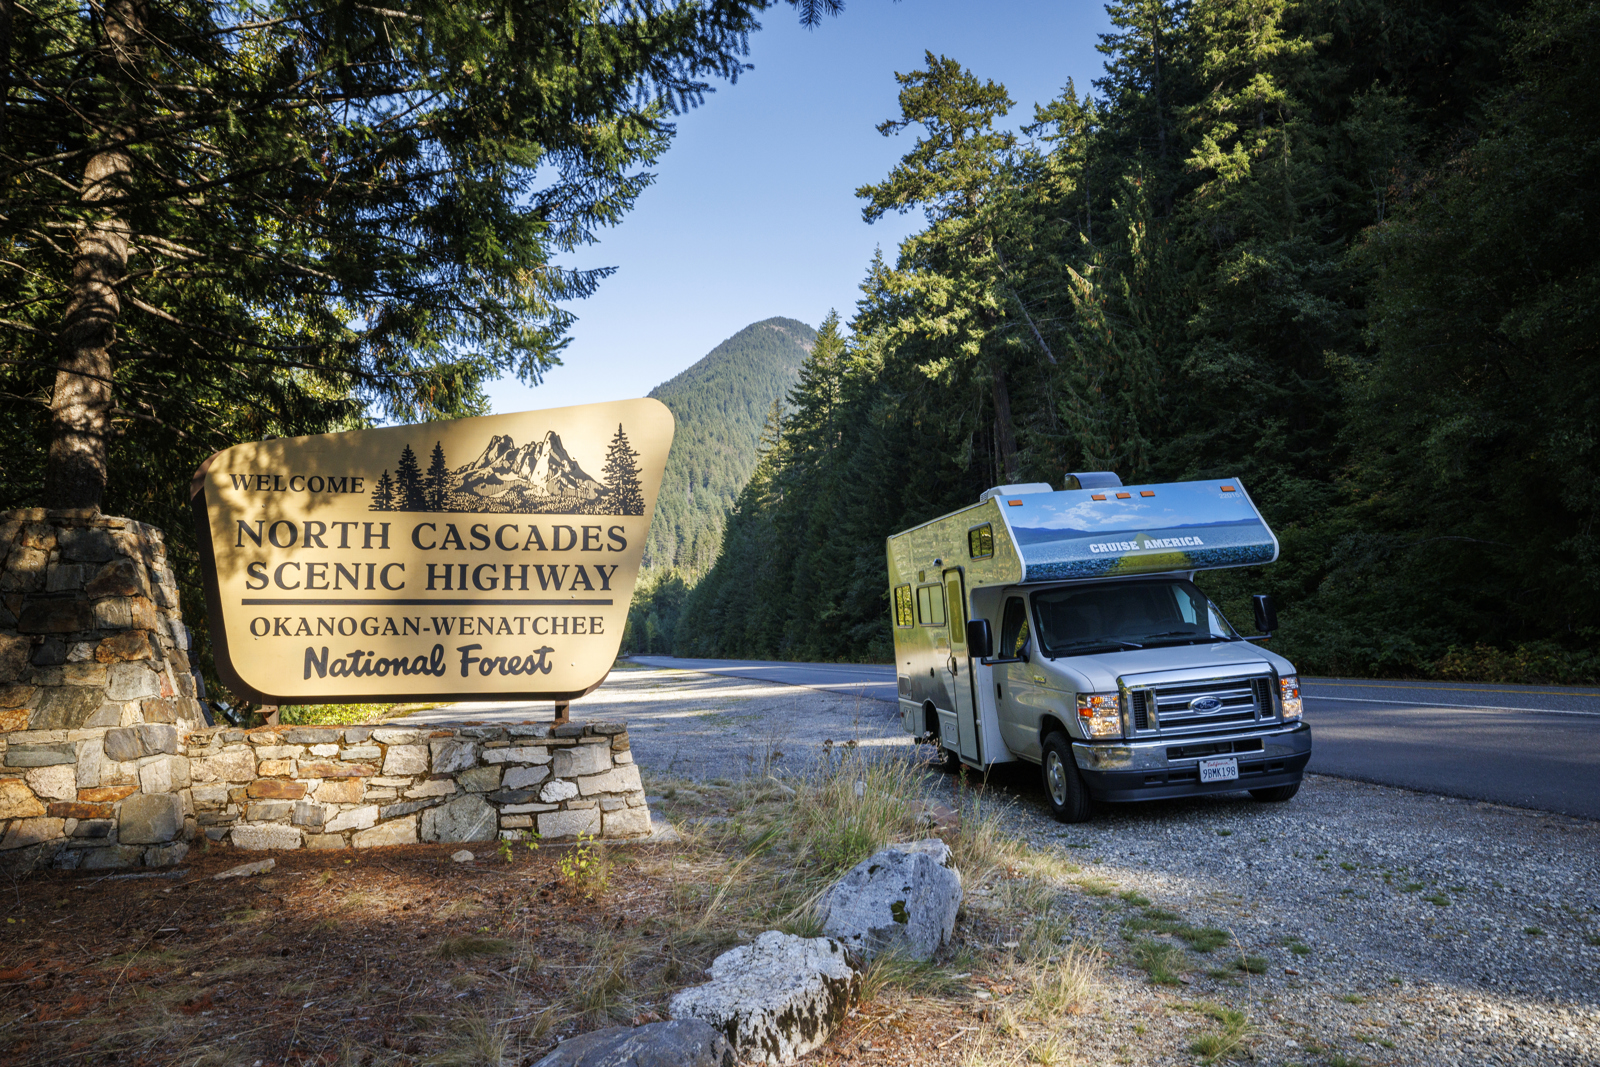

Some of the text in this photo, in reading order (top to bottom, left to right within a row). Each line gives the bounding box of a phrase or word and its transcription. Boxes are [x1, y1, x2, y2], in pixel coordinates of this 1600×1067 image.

[229, 473, 365, 494] WELCOME
[235, 519, 628, 552] NORTH CASCADES
[1089, 536, 1204, 553] CRUISE AMERICA
[246, 561, 618, 591] SCENIC HIGHWAY
[249, 616, 605, 637] OKANOGAN-WENATCHEE
[303, 644, 555, 681] National Forest
[1202, 766, 1236, 779] 9BMK198
